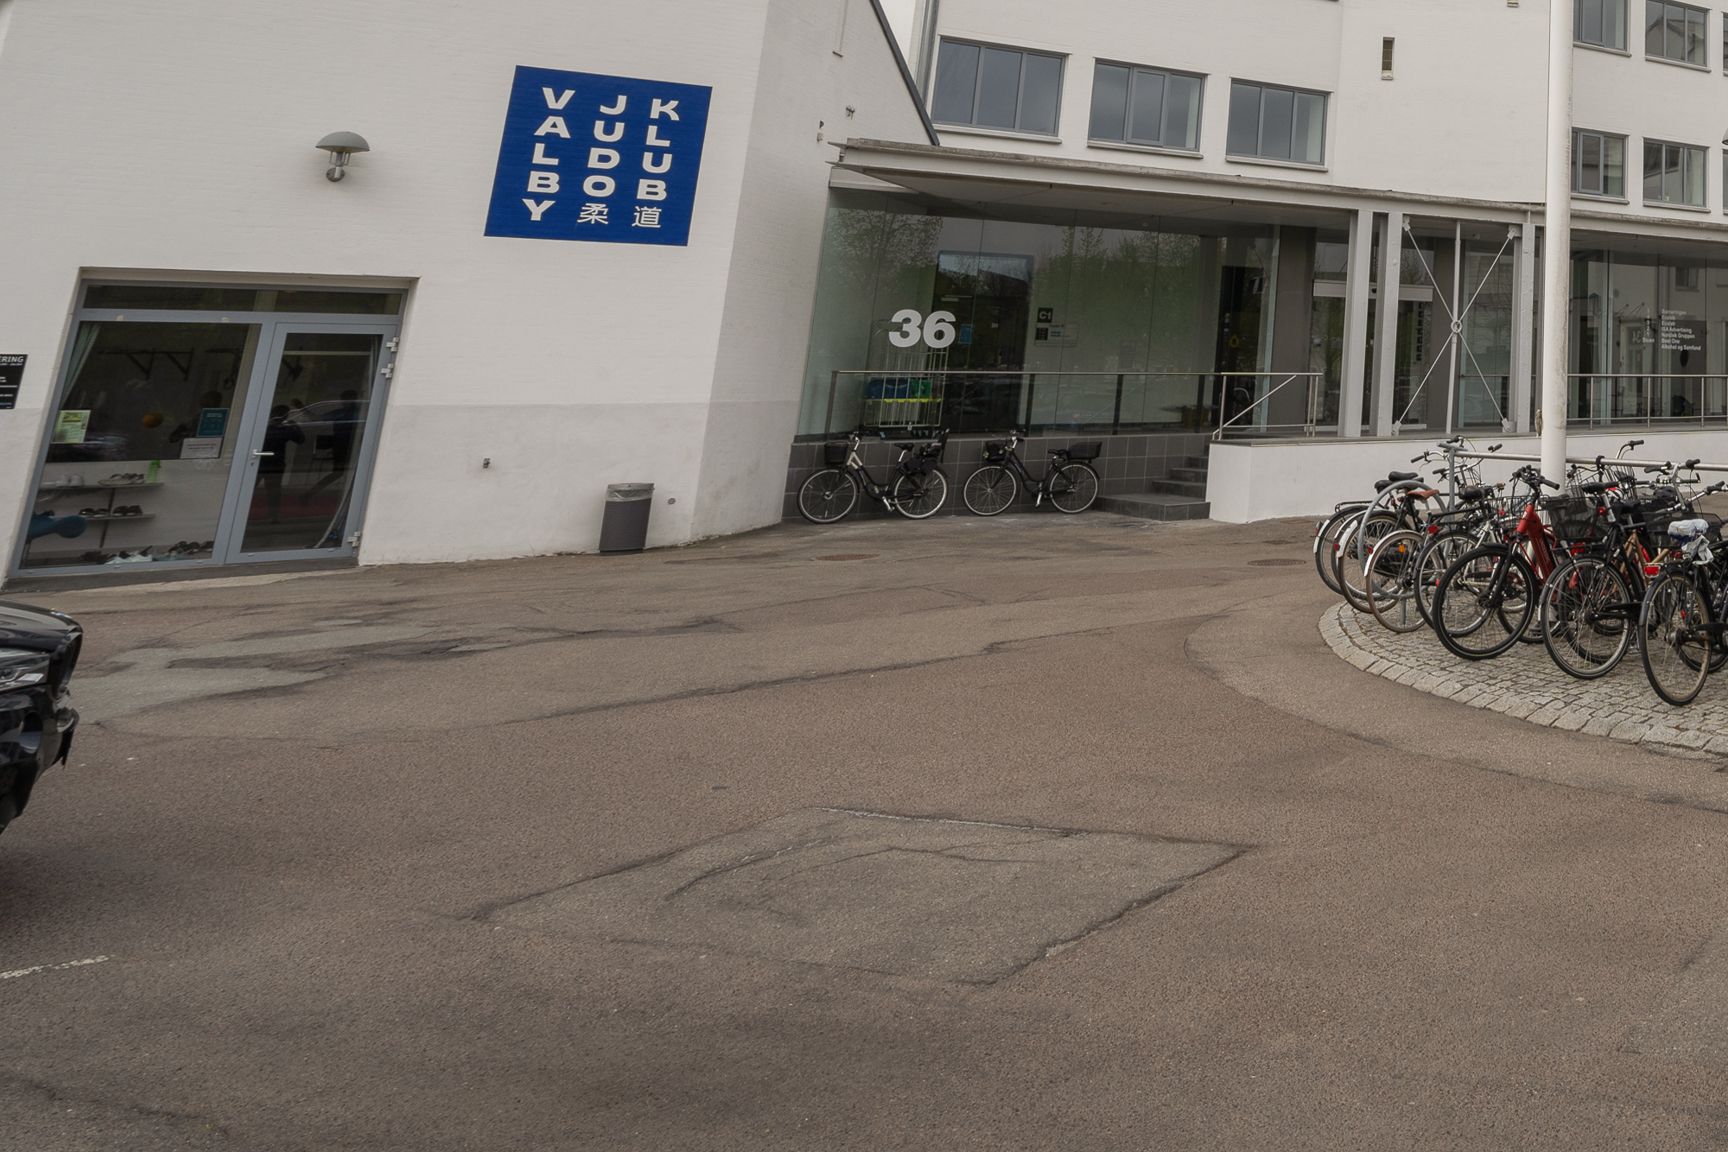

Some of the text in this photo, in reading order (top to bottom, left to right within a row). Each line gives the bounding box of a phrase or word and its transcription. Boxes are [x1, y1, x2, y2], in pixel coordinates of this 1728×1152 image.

[522, 87, 576, 221] VALBY
[582, 95, 627, 197] JUDO
[636, 98, 680, 201] KLUB
[888, 310, 957, 348] 36
